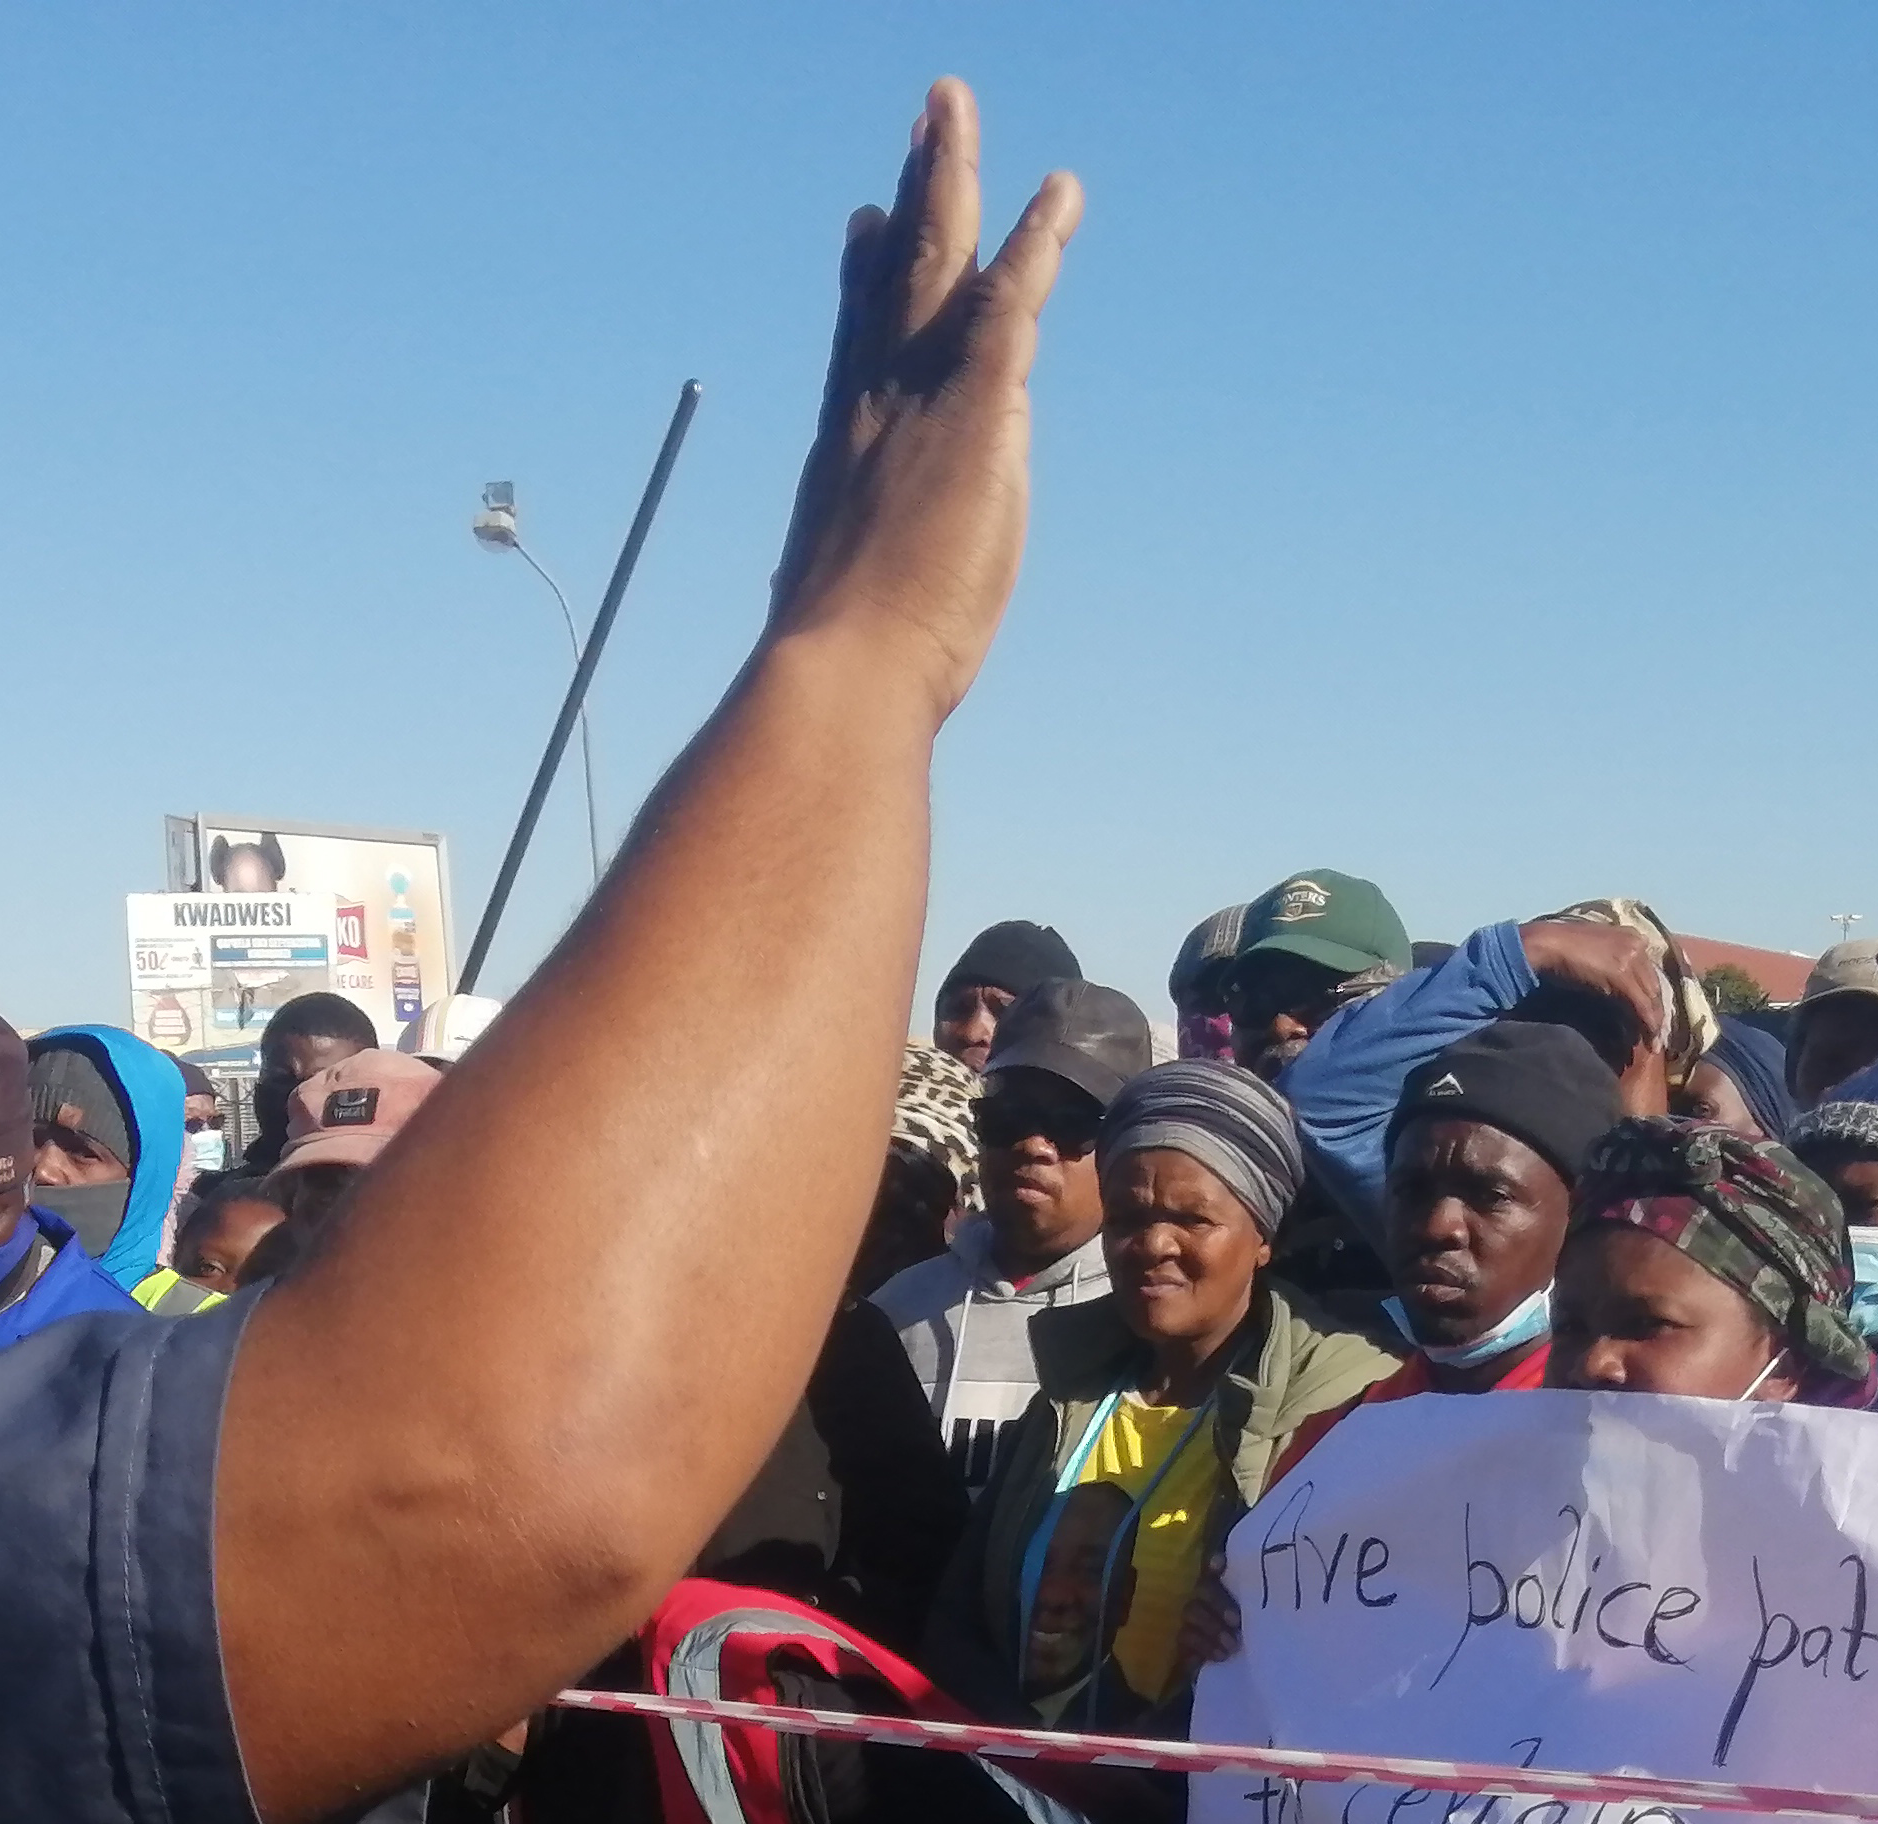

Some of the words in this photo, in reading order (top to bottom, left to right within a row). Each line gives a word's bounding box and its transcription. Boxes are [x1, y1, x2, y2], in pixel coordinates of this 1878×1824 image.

[174, 902, 292, 927] KWADWESI
[1260, 1480, 1400, 1615] Are
[1428, 1501, 1700, 1691] police
